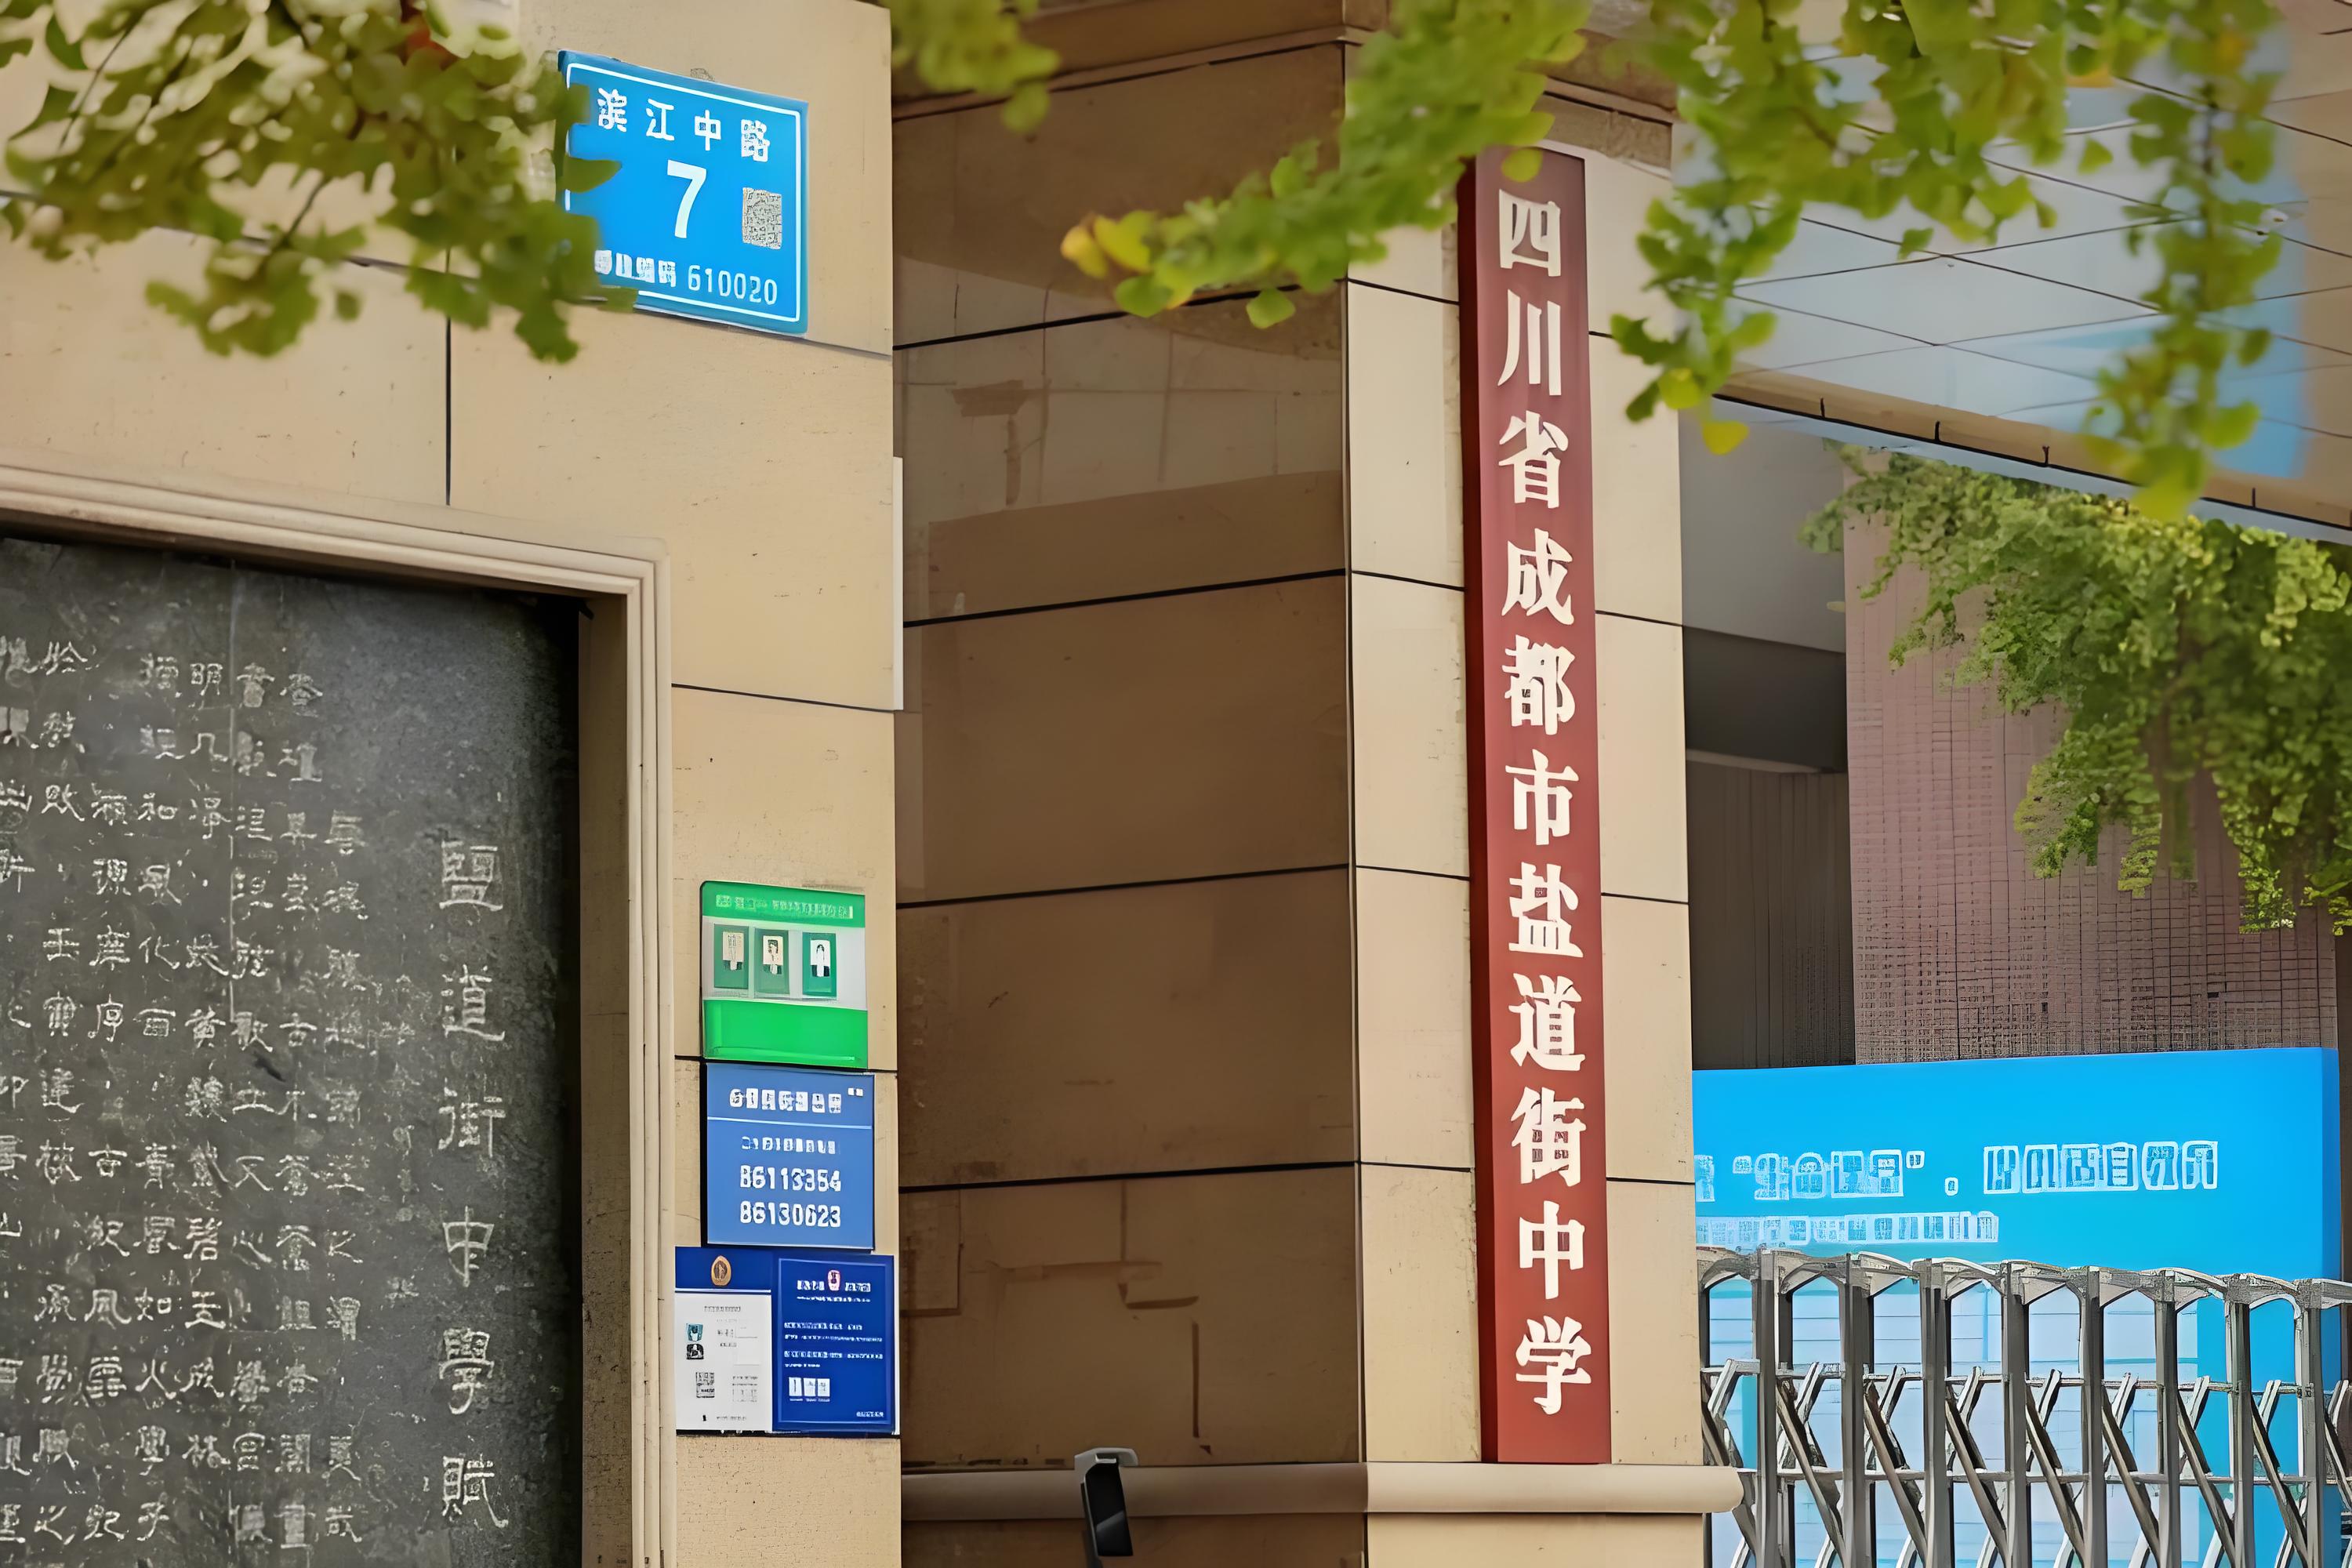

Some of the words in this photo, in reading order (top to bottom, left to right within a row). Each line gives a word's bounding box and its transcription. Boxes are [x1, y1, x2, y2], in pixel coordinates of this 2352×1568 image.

[597, 87, 771, 162] 滨江中路
[666, 159, 707, 238] 7
[688, 264, 778, 305] 610020
[1497, 188, 1593, 1416] 四川省成都市盐道街中学
